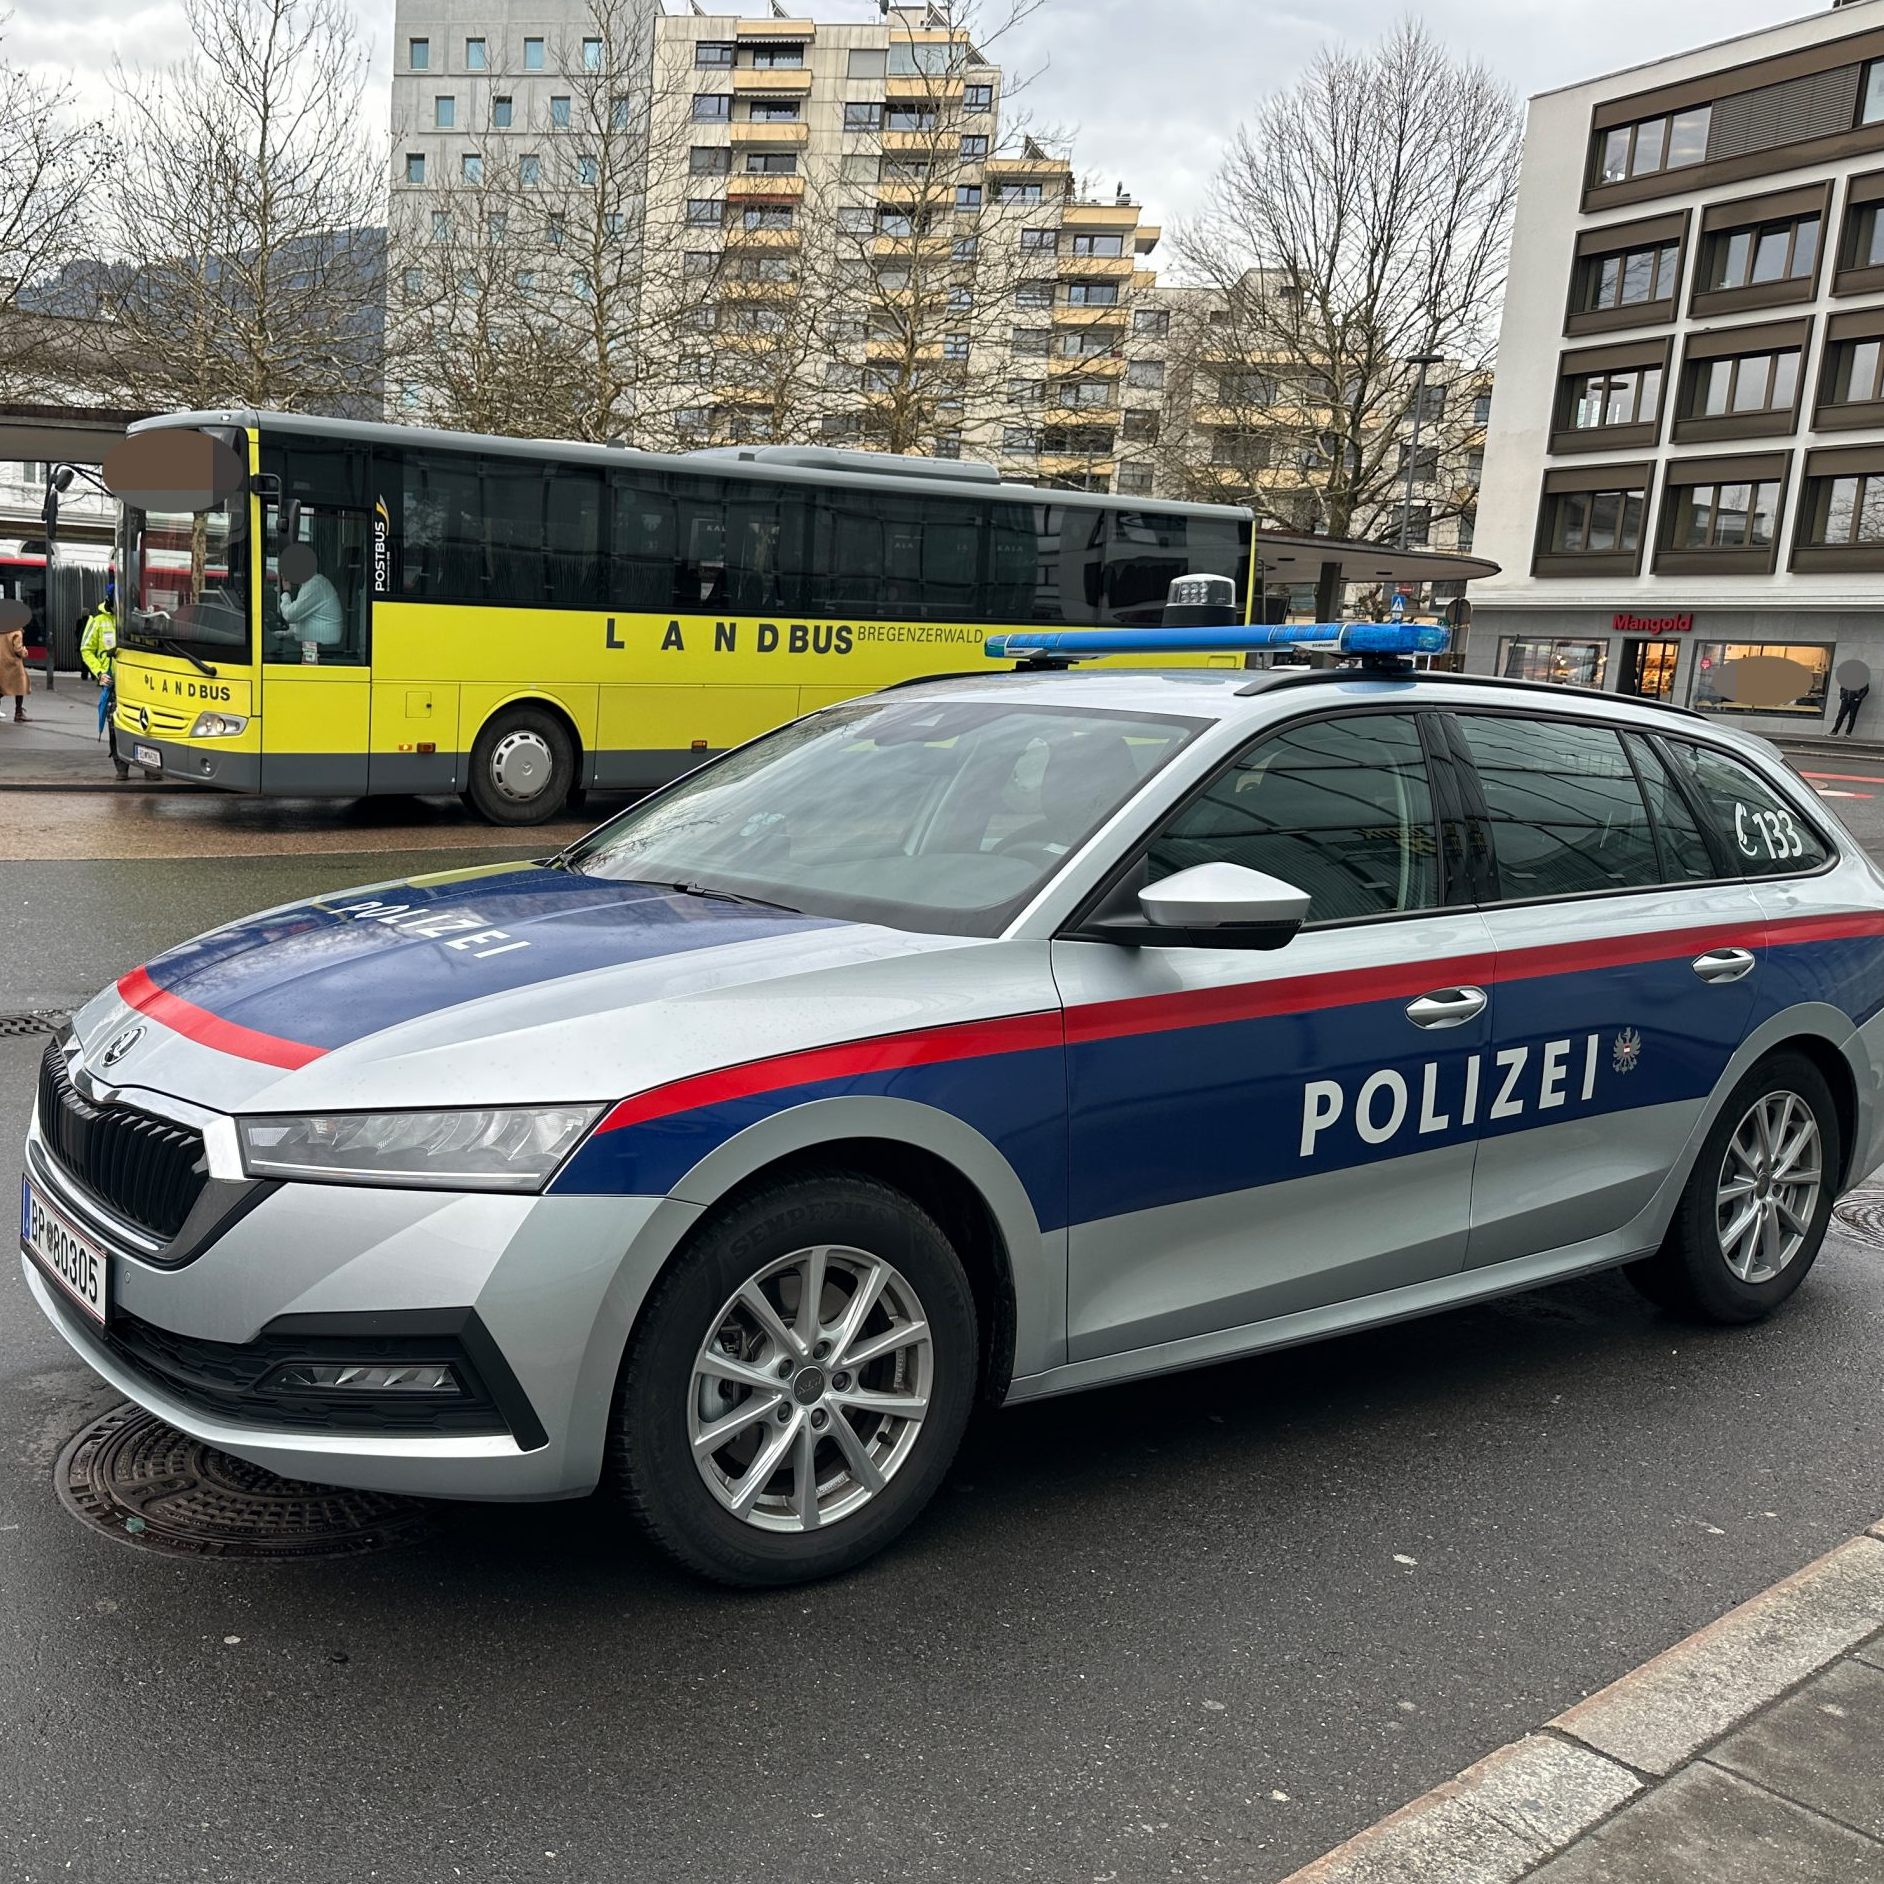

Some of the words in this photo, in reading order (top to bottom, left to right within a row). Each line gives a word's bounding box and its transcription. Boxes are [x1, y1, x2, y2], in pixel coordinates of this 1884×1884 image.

[375, 522, 385, 591] POSTBUS
[606, 618, 853, 654] LANDBUS
[858, 625, 984, 643] BREGENZERWALD
[1613, 613, 1693, 635] Mangold
[150, 676, 231, 701] LANDBUS
[1752, 810, 1803, 859] 133
[328, 901, 531, 958] POLIZEI
[1300, 1034, 1599, 1157] POLIZEI
[32, 1199, 45, 1247] BP
[53, 1223, 98, 1303] 80305
